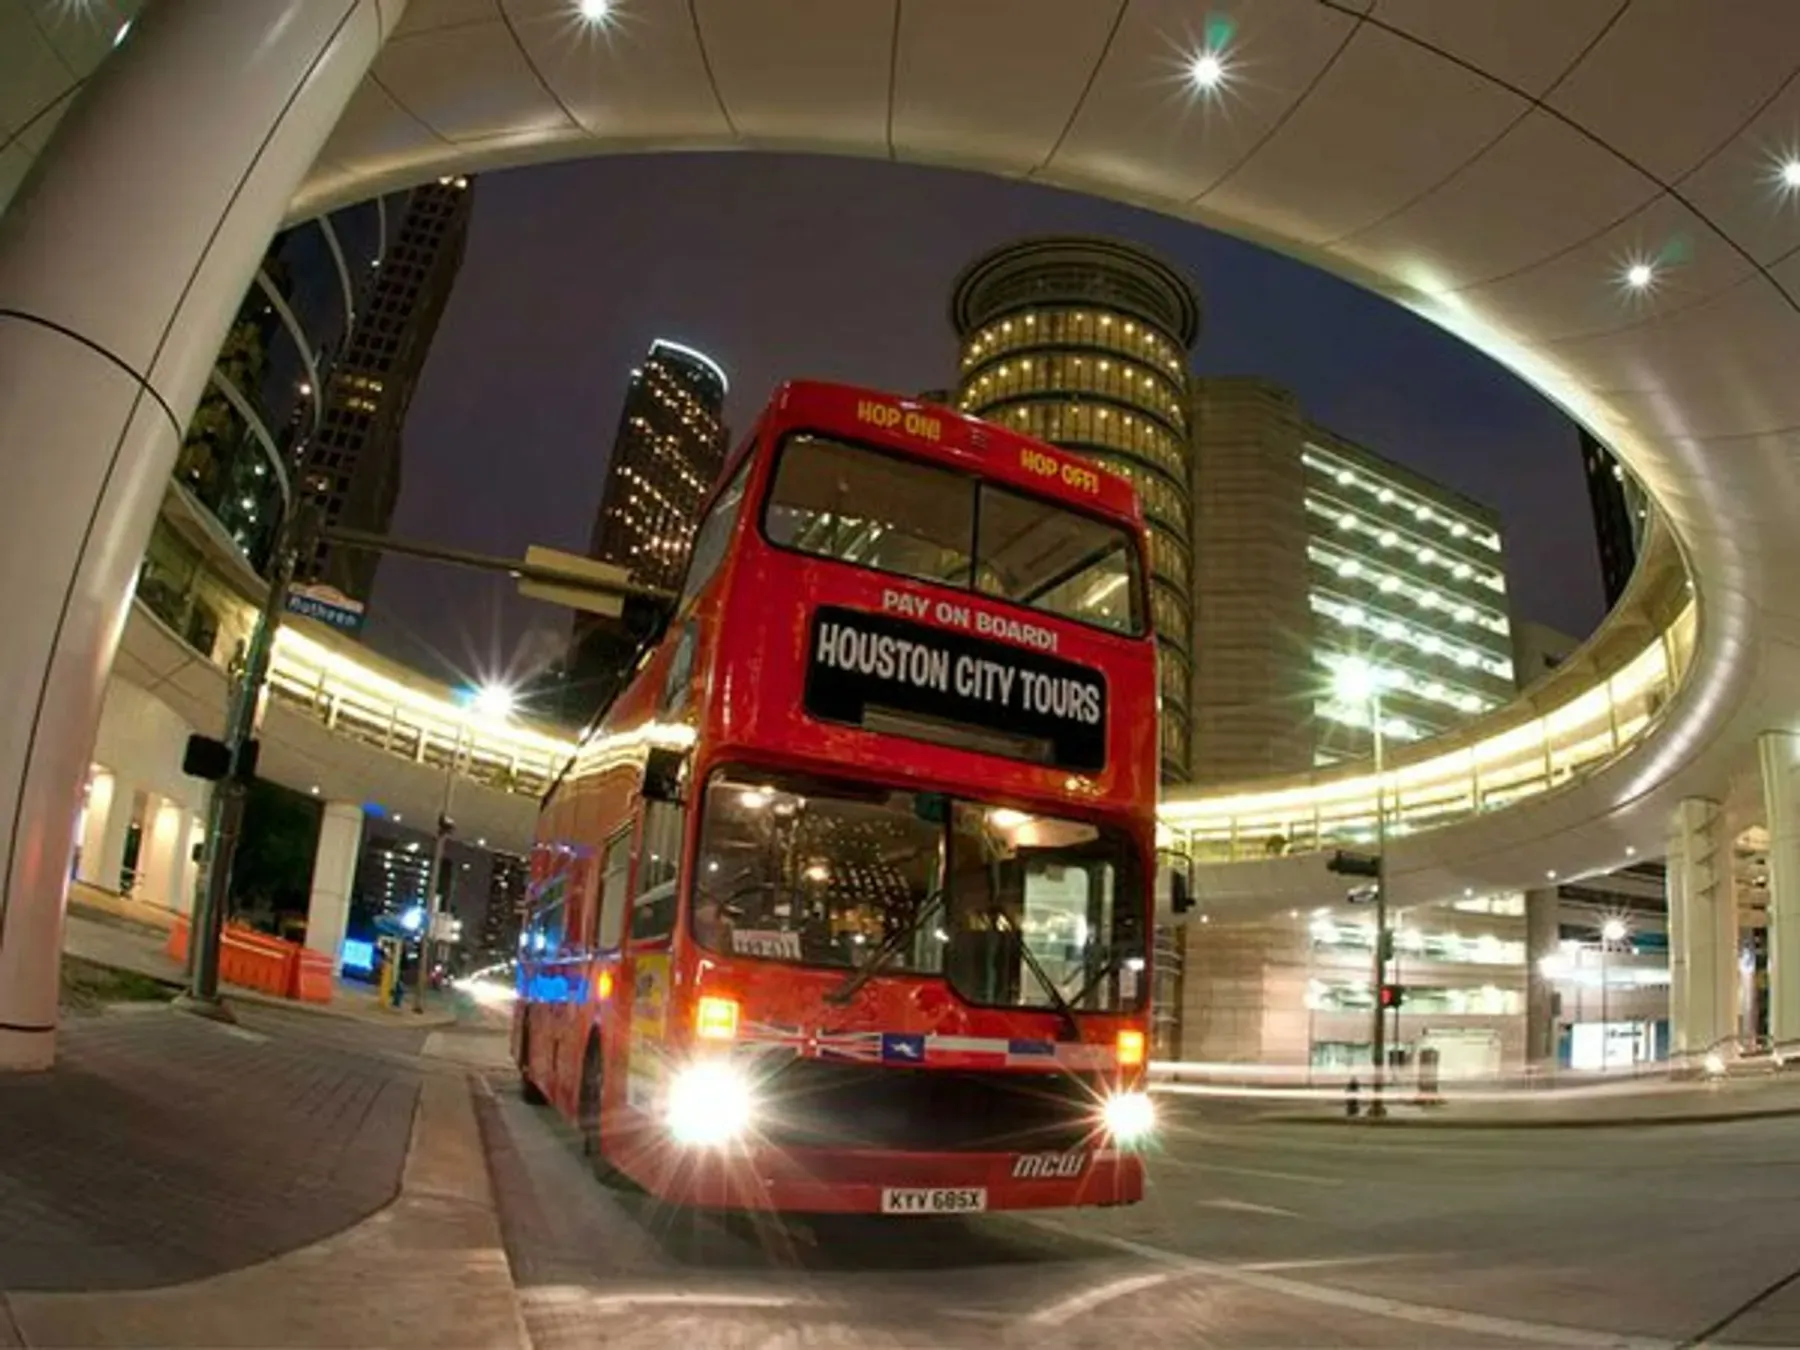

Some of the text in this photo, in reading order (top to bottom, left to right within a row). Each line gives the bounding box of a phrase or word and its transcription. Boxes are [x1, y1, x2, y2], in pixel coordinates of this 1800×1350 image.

[858, 400, 901, 428] HOP
[1021, 448, 1058, 477] HOP
[883, 589, 1058, 653] PAY ON BOARD!
[817, 623, 1100, 725] HOUSTON CITY TOURS
